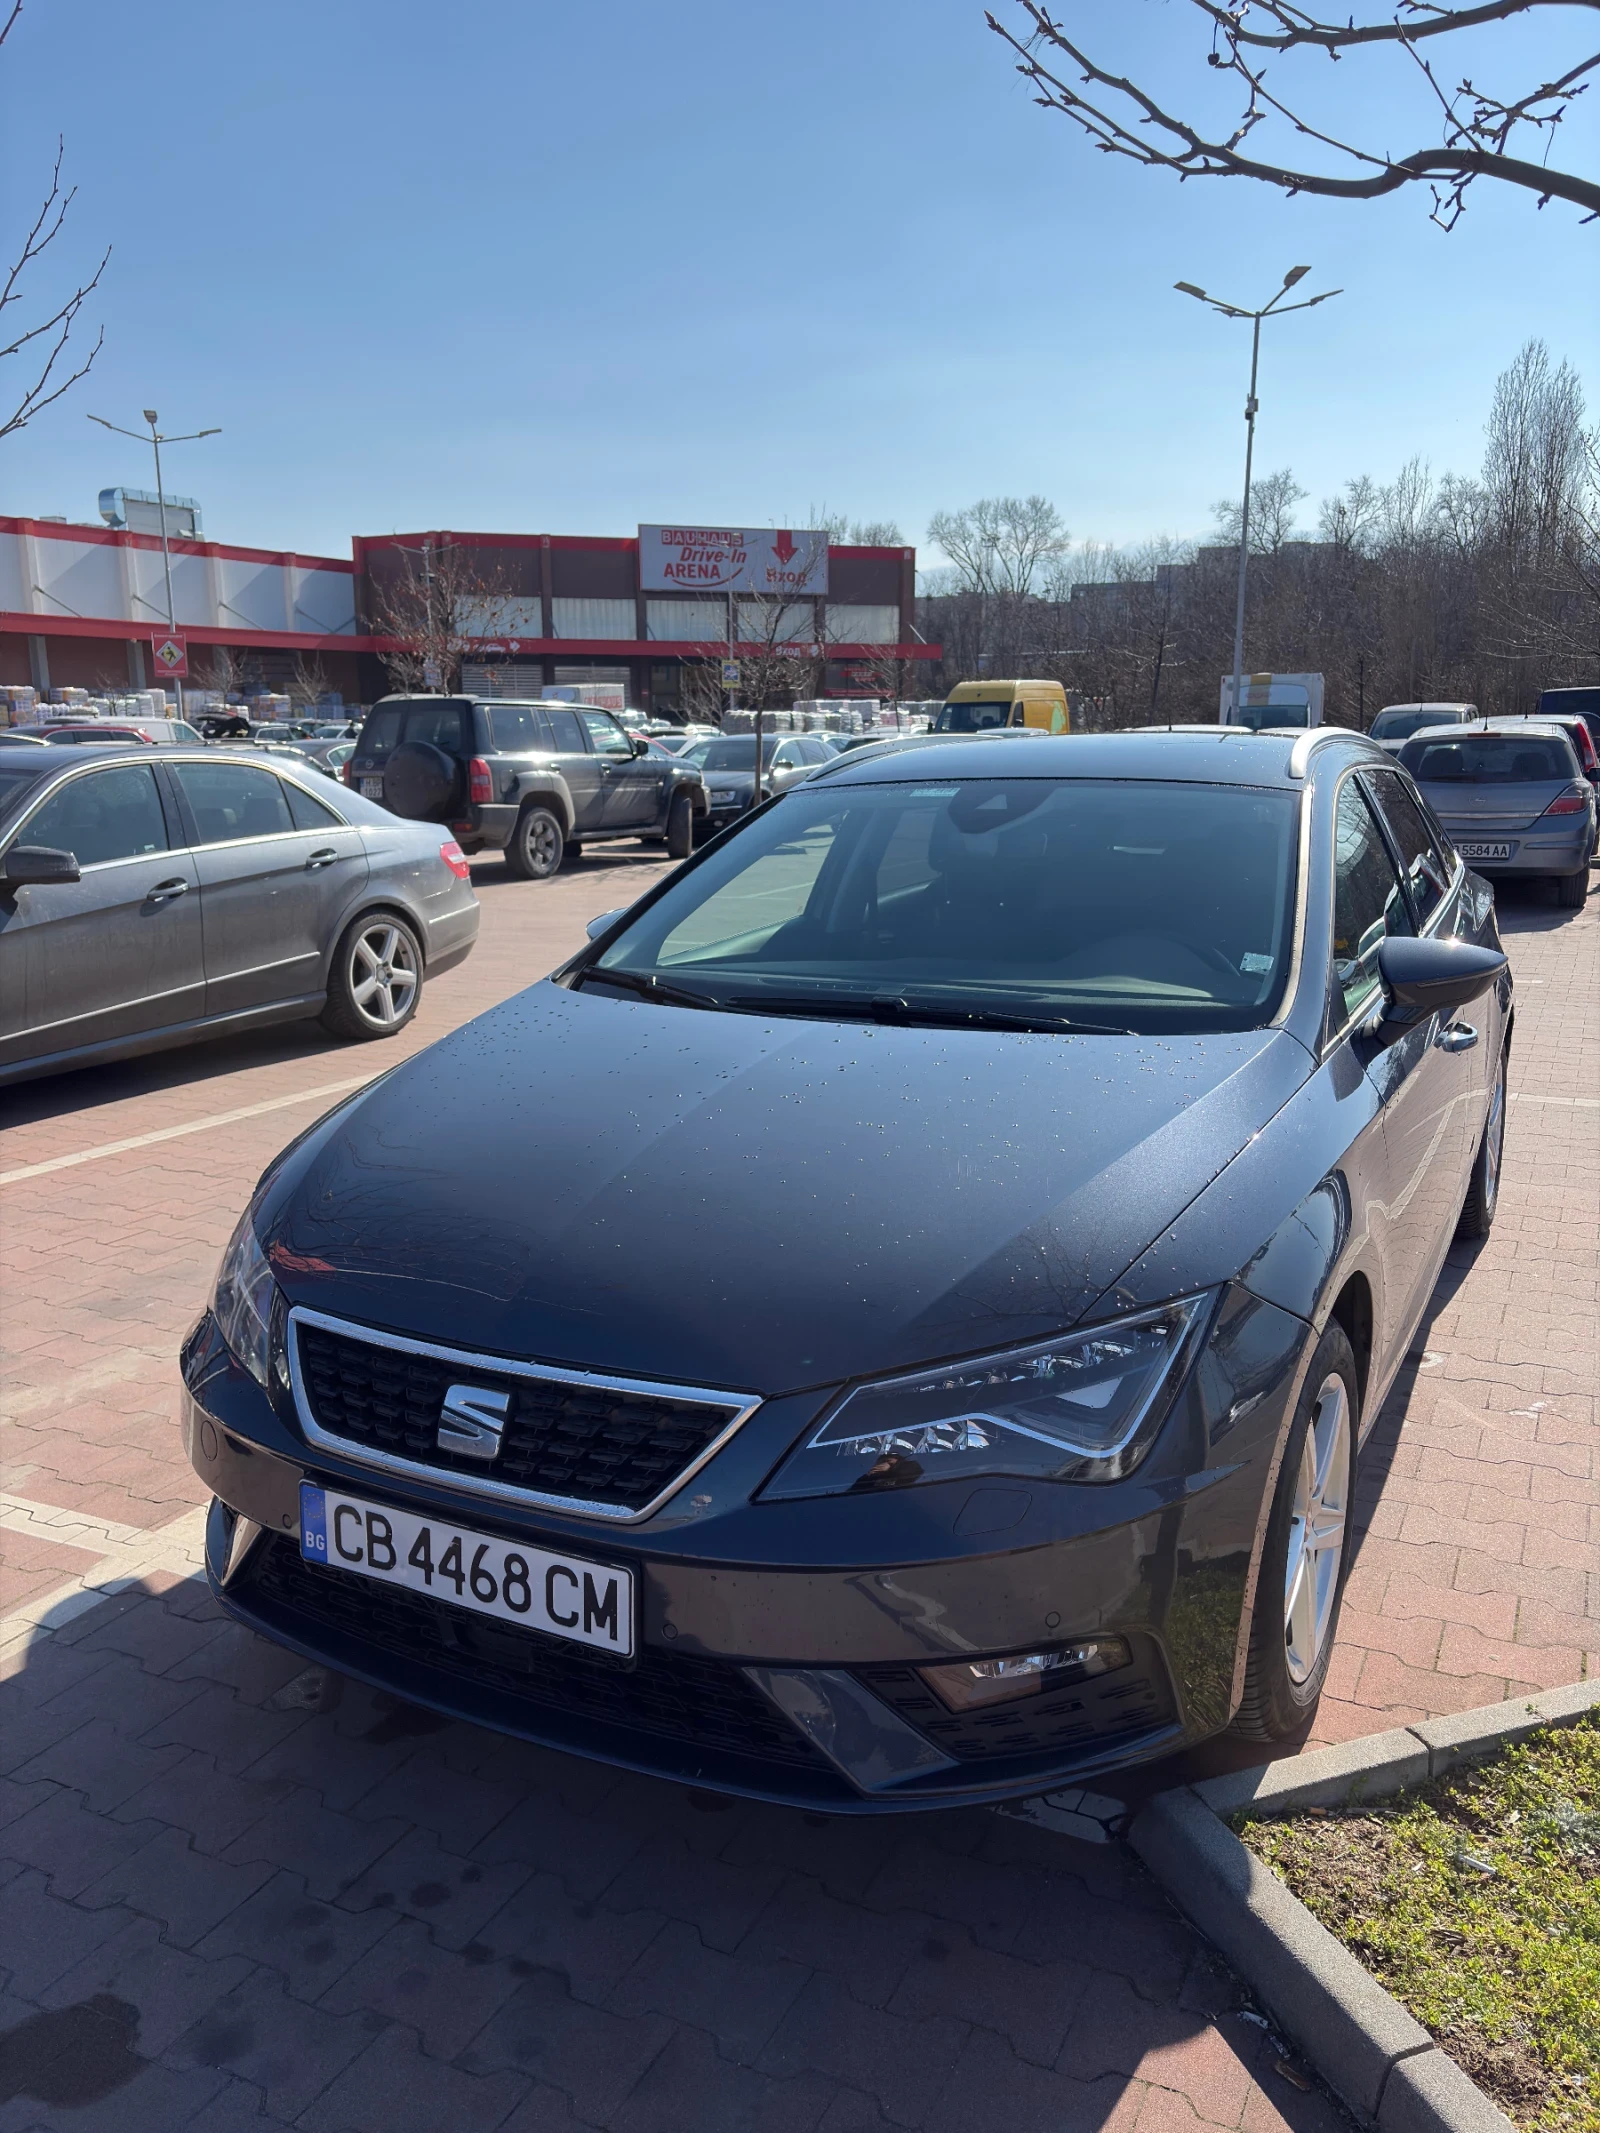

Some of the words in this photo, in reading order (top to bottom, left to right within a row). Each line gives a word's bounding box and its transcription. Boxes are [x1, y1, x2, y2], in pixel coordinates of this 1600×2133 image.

[662, 530, 744, 547] BAUHAUS
[680, 547, 747, 563] Drive-In
[664, 563, 721, 579] ARENA
[766, 568, 807, 584] Вход
[775, 646, 801, 657] Вход
[1462, 845, 1490, 856] 5584
[1492, 845, 1507, 856] AA
[305, 1530, 325, 1551] BG
[333, 1504, 397, 1571] CB
[407, 1526, 532, 1613] 4468
[545, 1564, 618, 1641] CM
